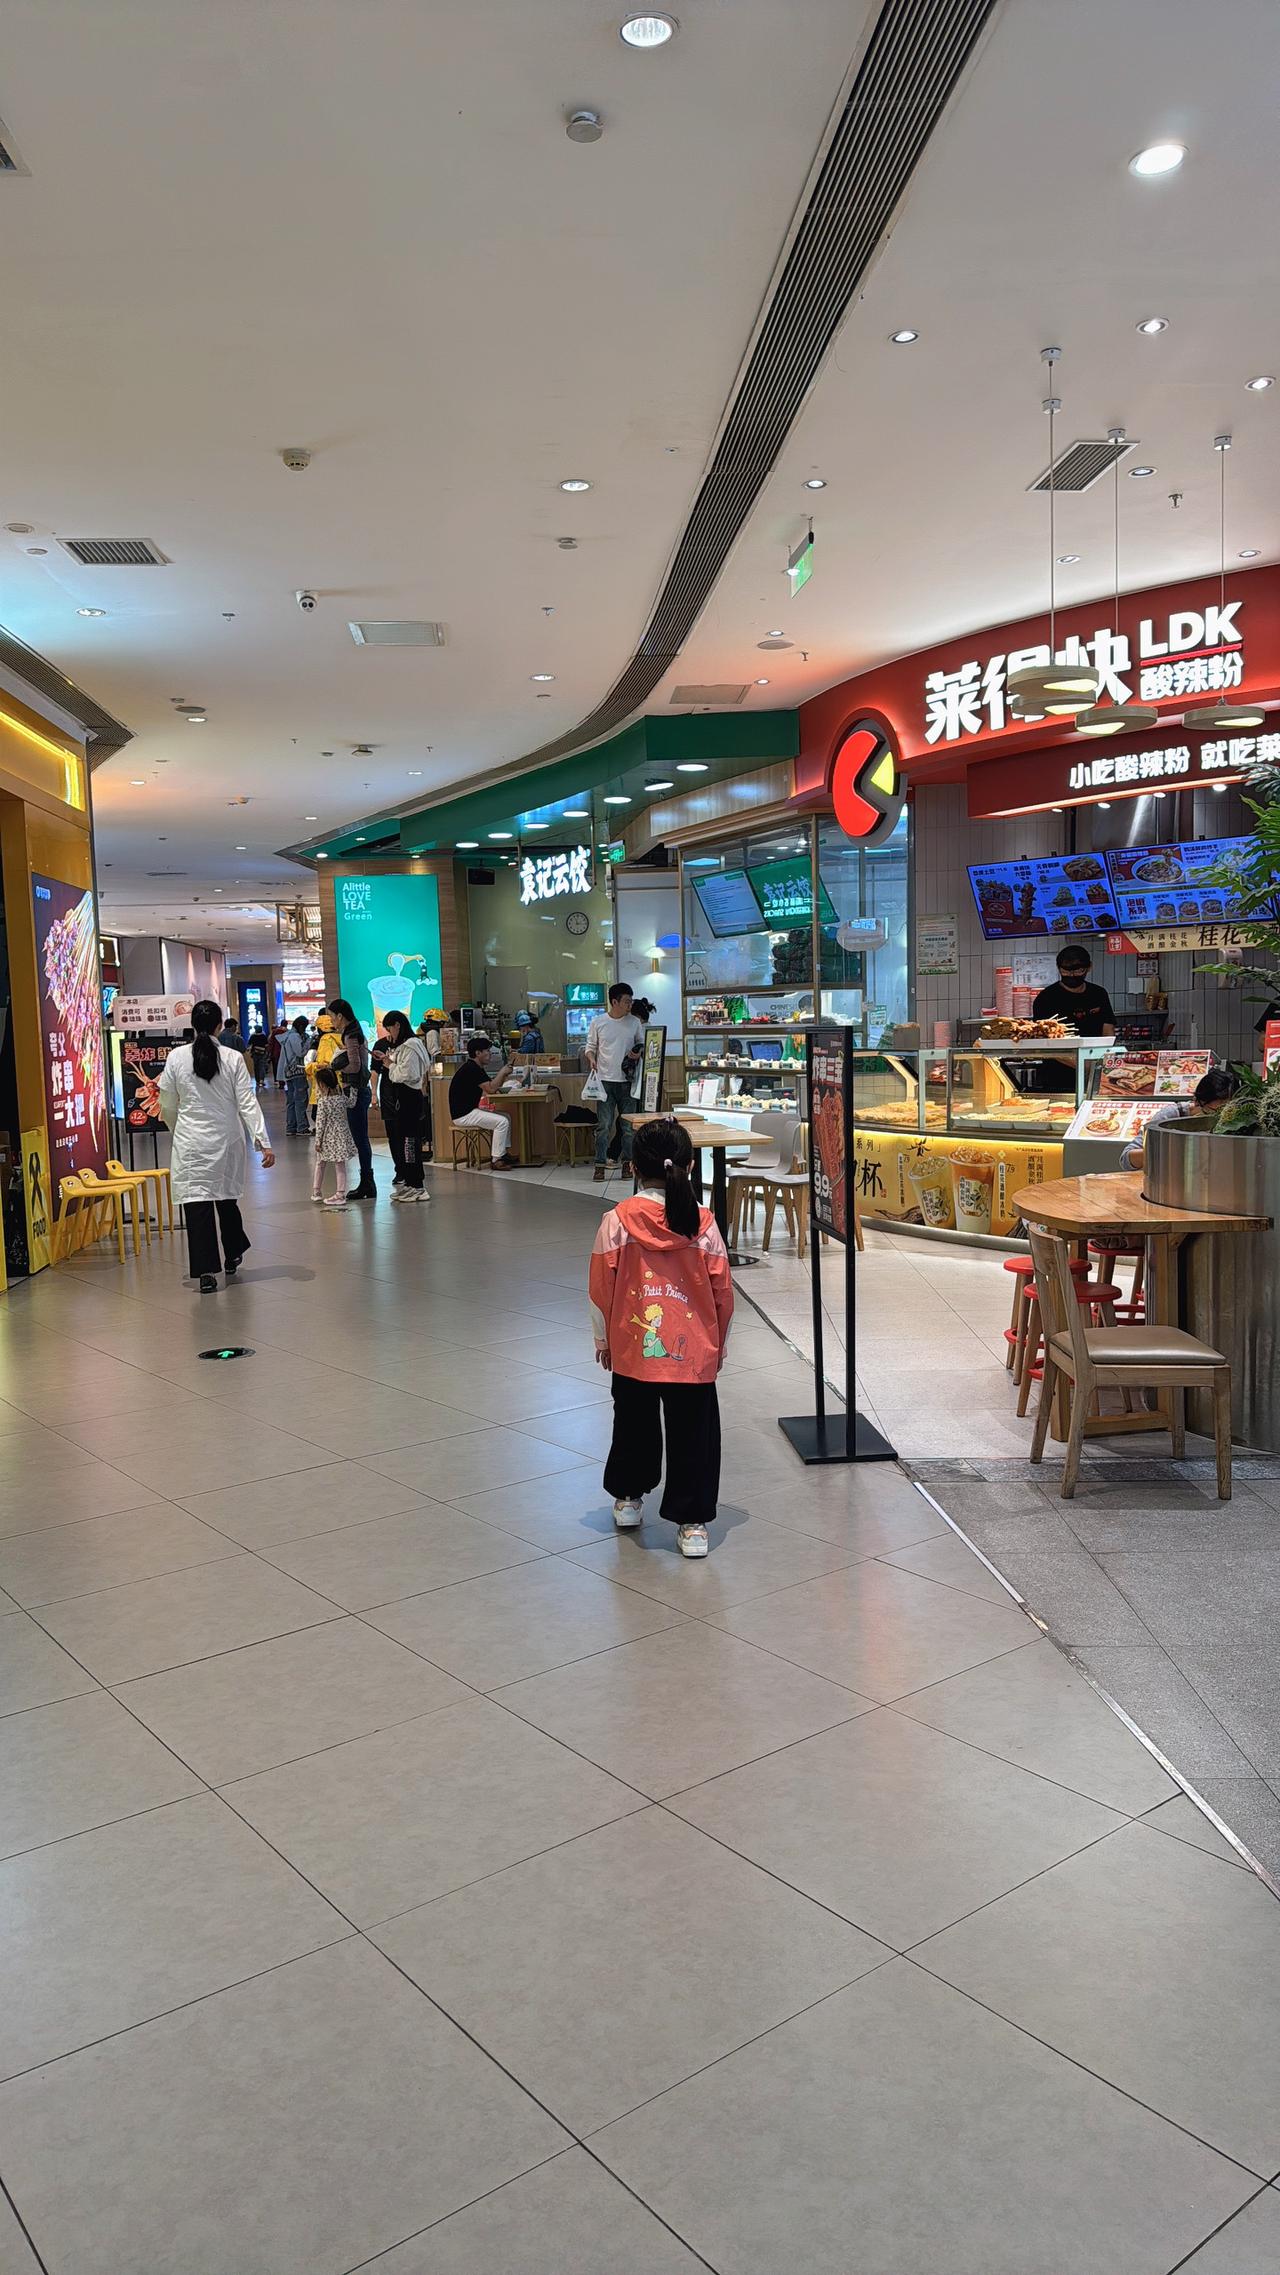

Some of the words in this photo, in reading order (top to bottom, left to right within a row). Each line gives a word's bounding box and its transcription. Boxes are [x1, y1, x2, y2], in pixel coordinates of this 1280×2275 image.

[1139, 601, 1244, 658] LDK
[1140, 652, 1244, 701] 酸辣粉
[1069, 746, 1190, 789] 小吃酸辣粉
[520, 845, 592, 905] 袁记云饺
[342, 882, 371, 891] Alittle
[342, 892, 371, 901] LOVE
[343, 901, 366, 910] TEA
[344, 912, 373, 920] Green
[1105, 1059, 1123, 1068] 9.9
[51, 1059, 75, 1096] 炸串
[852, 1158, 883, 1198] 杯
[33, 1217, 47, 1239] FOOD
[643, 1284, 663, 1297] Petit
[665, 1283, 689, 1304] Prince
